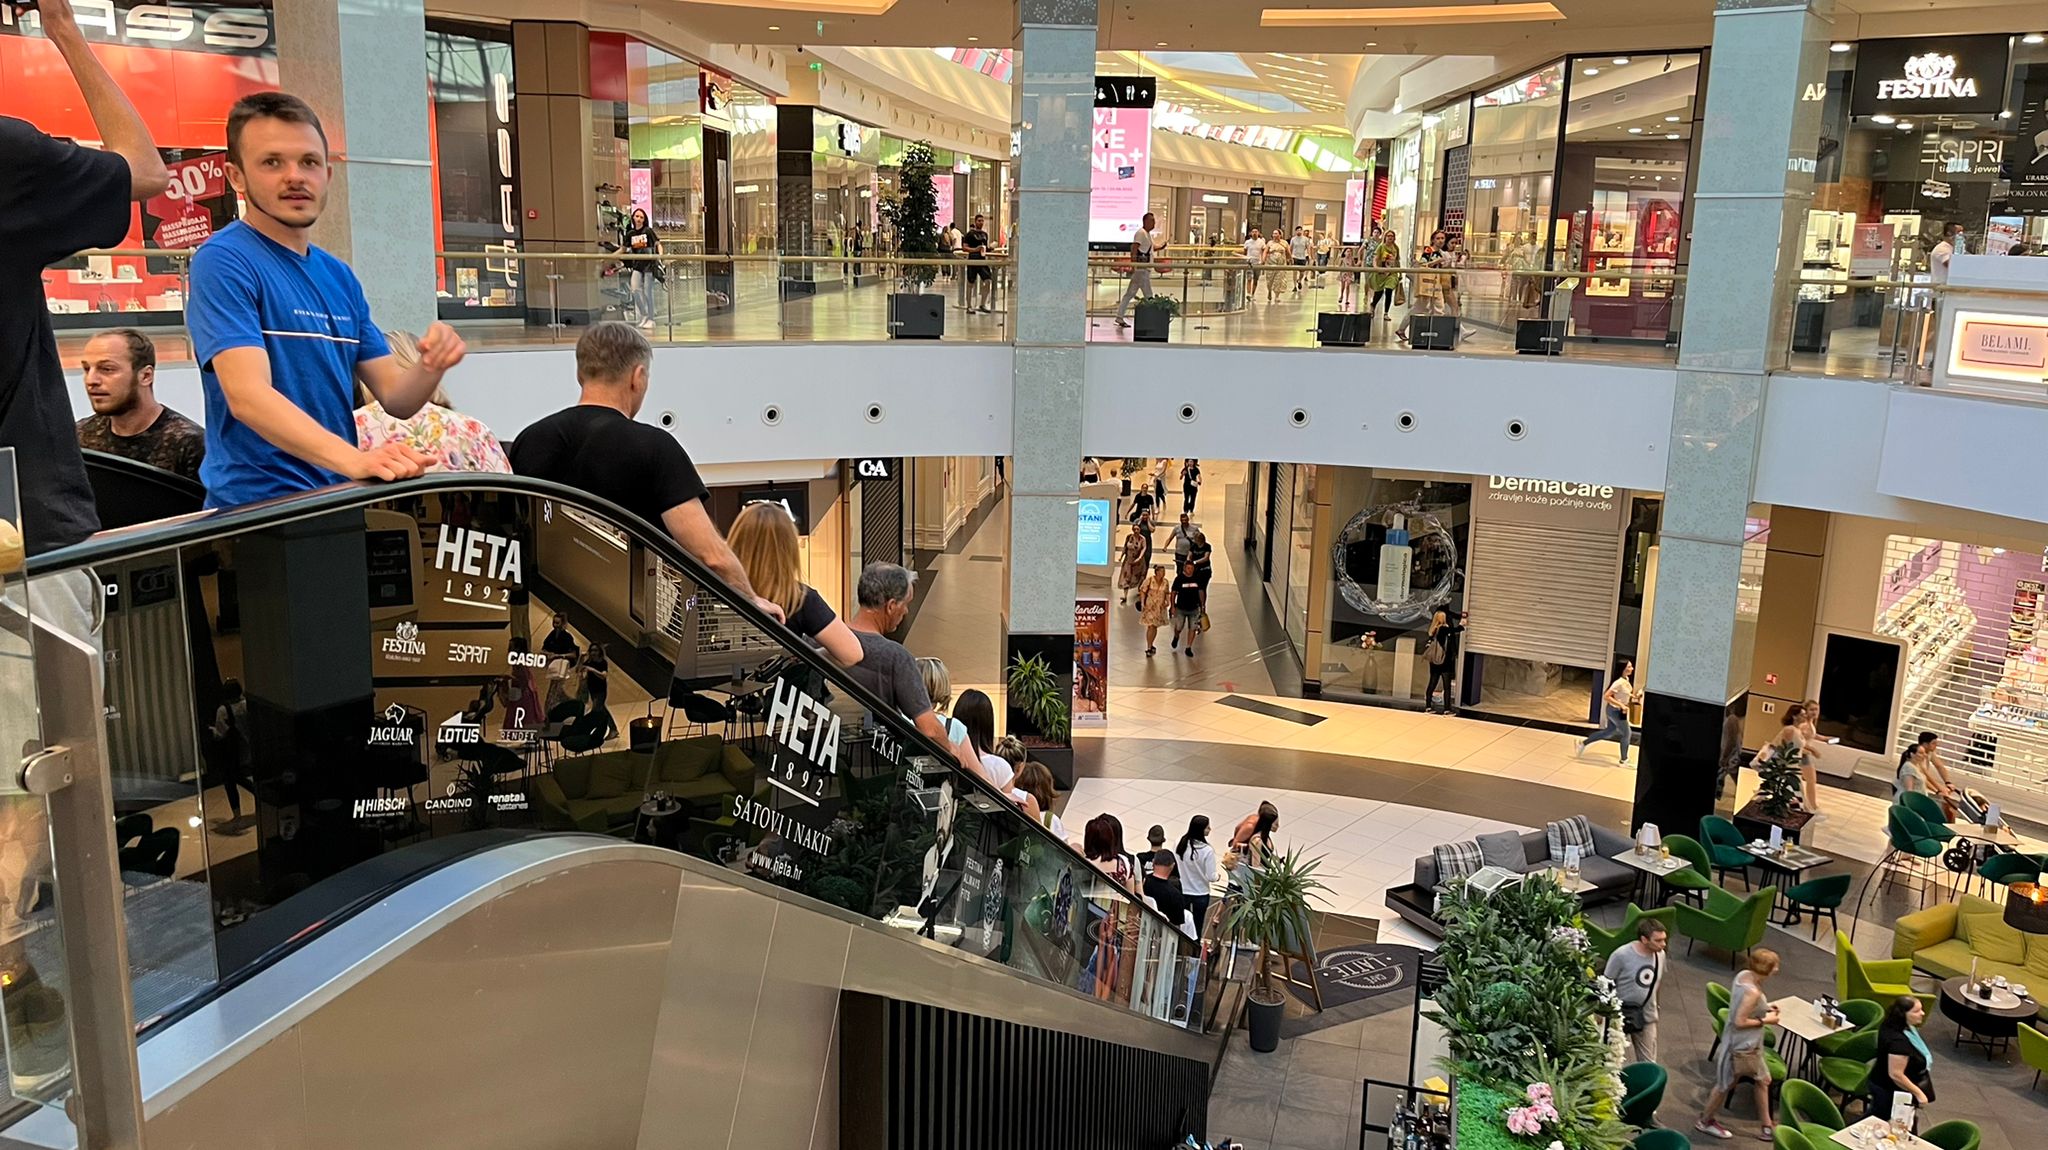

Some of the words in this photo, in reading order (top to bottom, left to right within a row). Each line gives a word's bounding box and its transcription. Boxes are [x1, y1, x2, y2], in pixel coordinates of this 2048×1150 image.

[1876, 77, 1978, 100] FESTINA
[1489, 475, 1614, 499] DermaCare
[434, 524, 522, 584] HETA
[382, 637, 426, 655] FESTINA
[448, 643, 492, 664] ESPRIT
[507, 651, 546, 668] CASIO
[766, 676, 841, 774] HETA
[367, 727, 414, 745] JAGUAR
[438, 728, 480, 743] LOTUS
[366, 798, 406, 811] HIRSCH
[425, 798, 472, 810] CANDINO
[732, 795, 784, 836] SATOVI
[793, 822, 833, 857] NAKIT
[752, 851, 802, 881] www.heta.hr
[1331, 957, 1387, 977] LATTE
